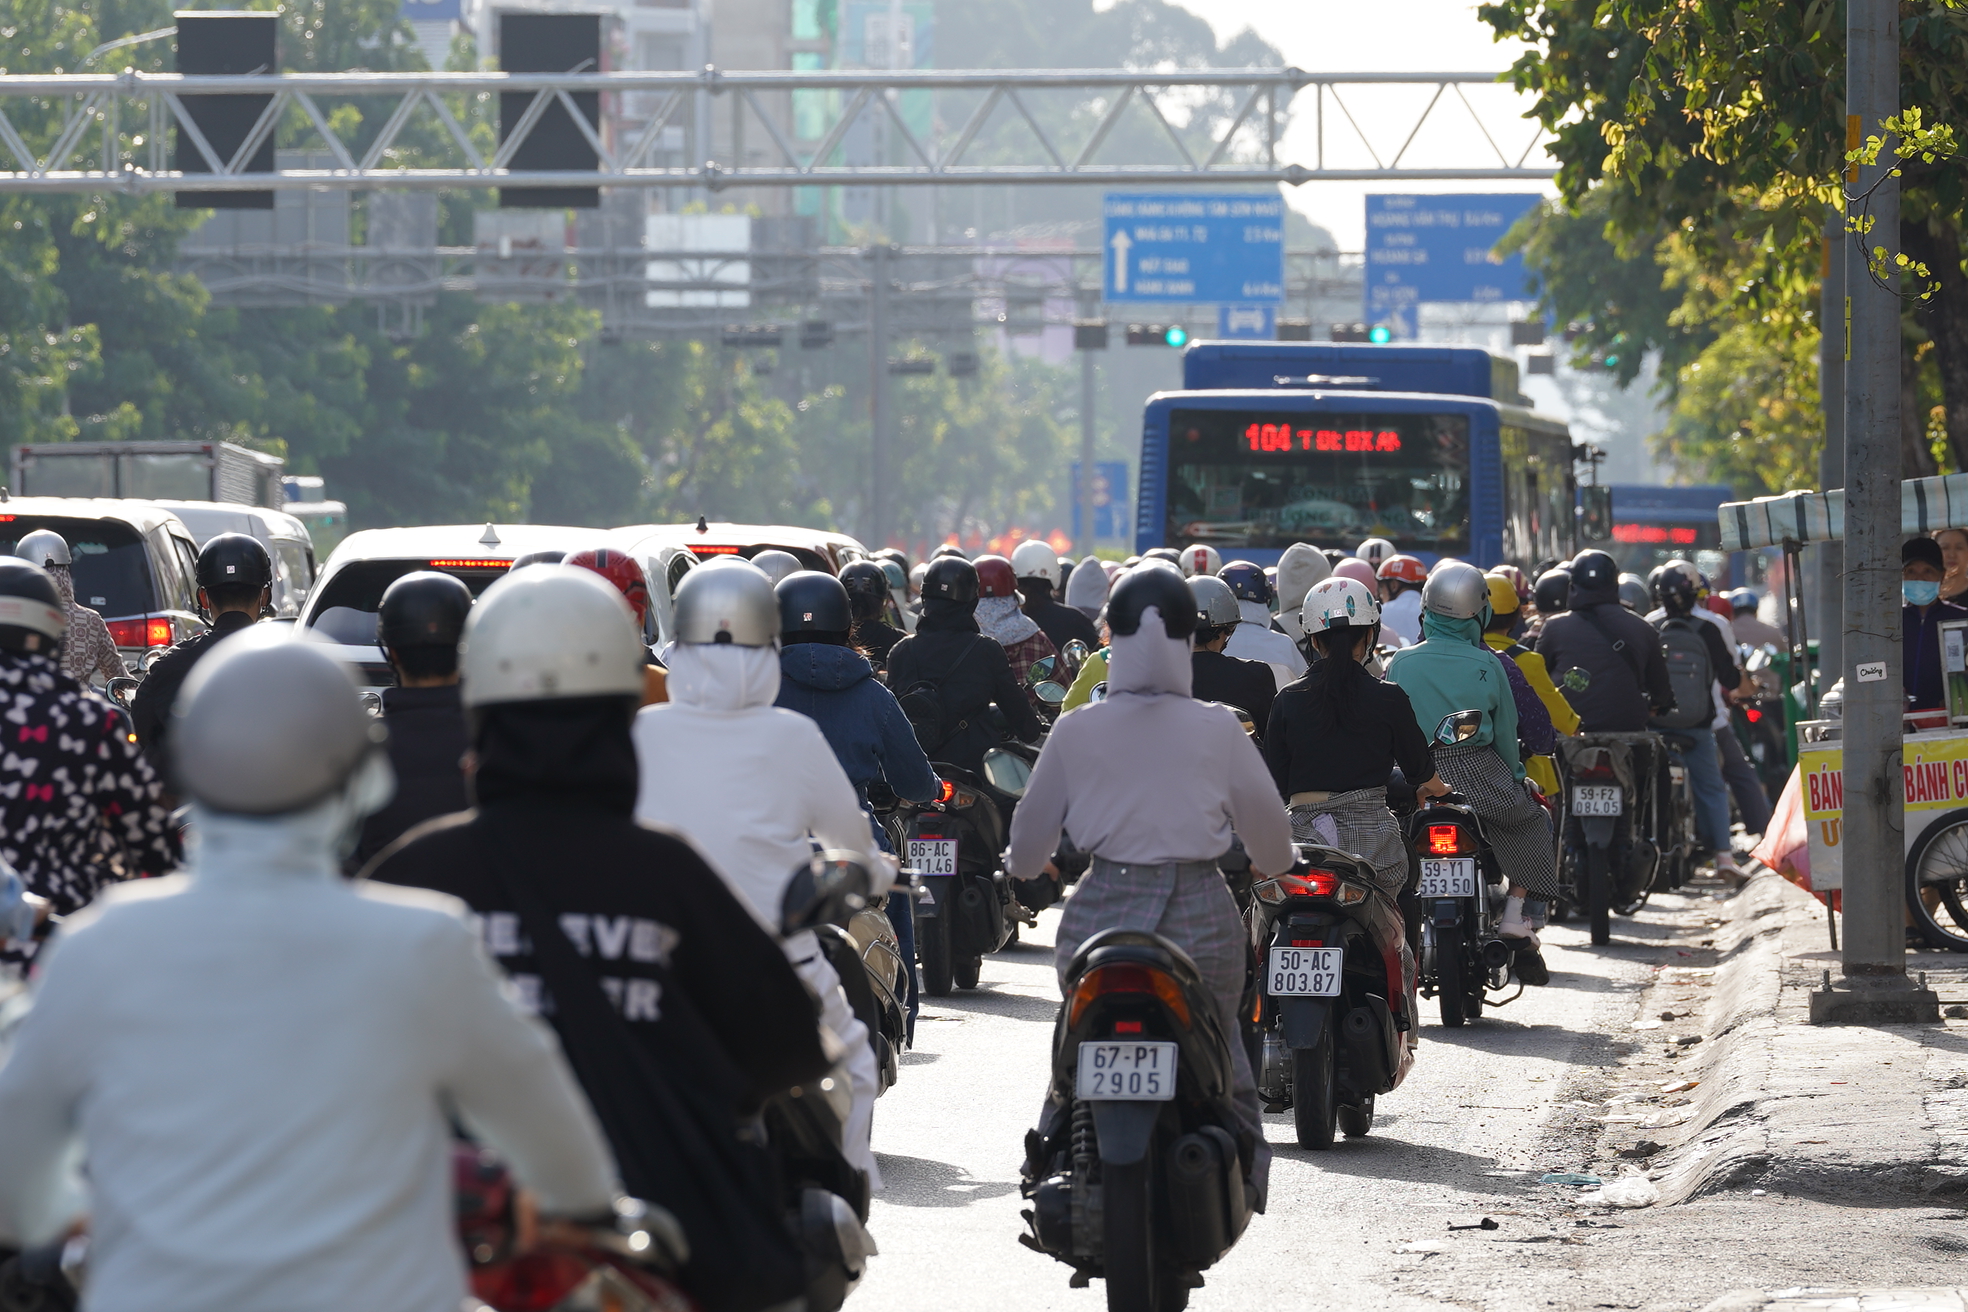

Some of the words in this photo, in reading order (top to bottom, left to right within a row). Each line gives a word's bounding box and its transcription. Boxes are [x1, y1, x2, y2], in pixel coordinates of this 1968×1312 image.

[1245, 423, 1292, 451] 104
[1903, 755, 1950, 803] BÁNH
[1580, 788, 1615, 801] 59-F2
[911, 842, 949, 857] 86-AC
[1425, 861, 1463, 877] 59-Y1
[1420, 878, 1470, 894] 553.50
[1280, 951, 1331, 971] 50-AC
[1274, 972, 1335, 993] 803.87
[1094, 1047, 1158, 1069] 67-P1
[1092, 1072, 1159, 1094] 2905
